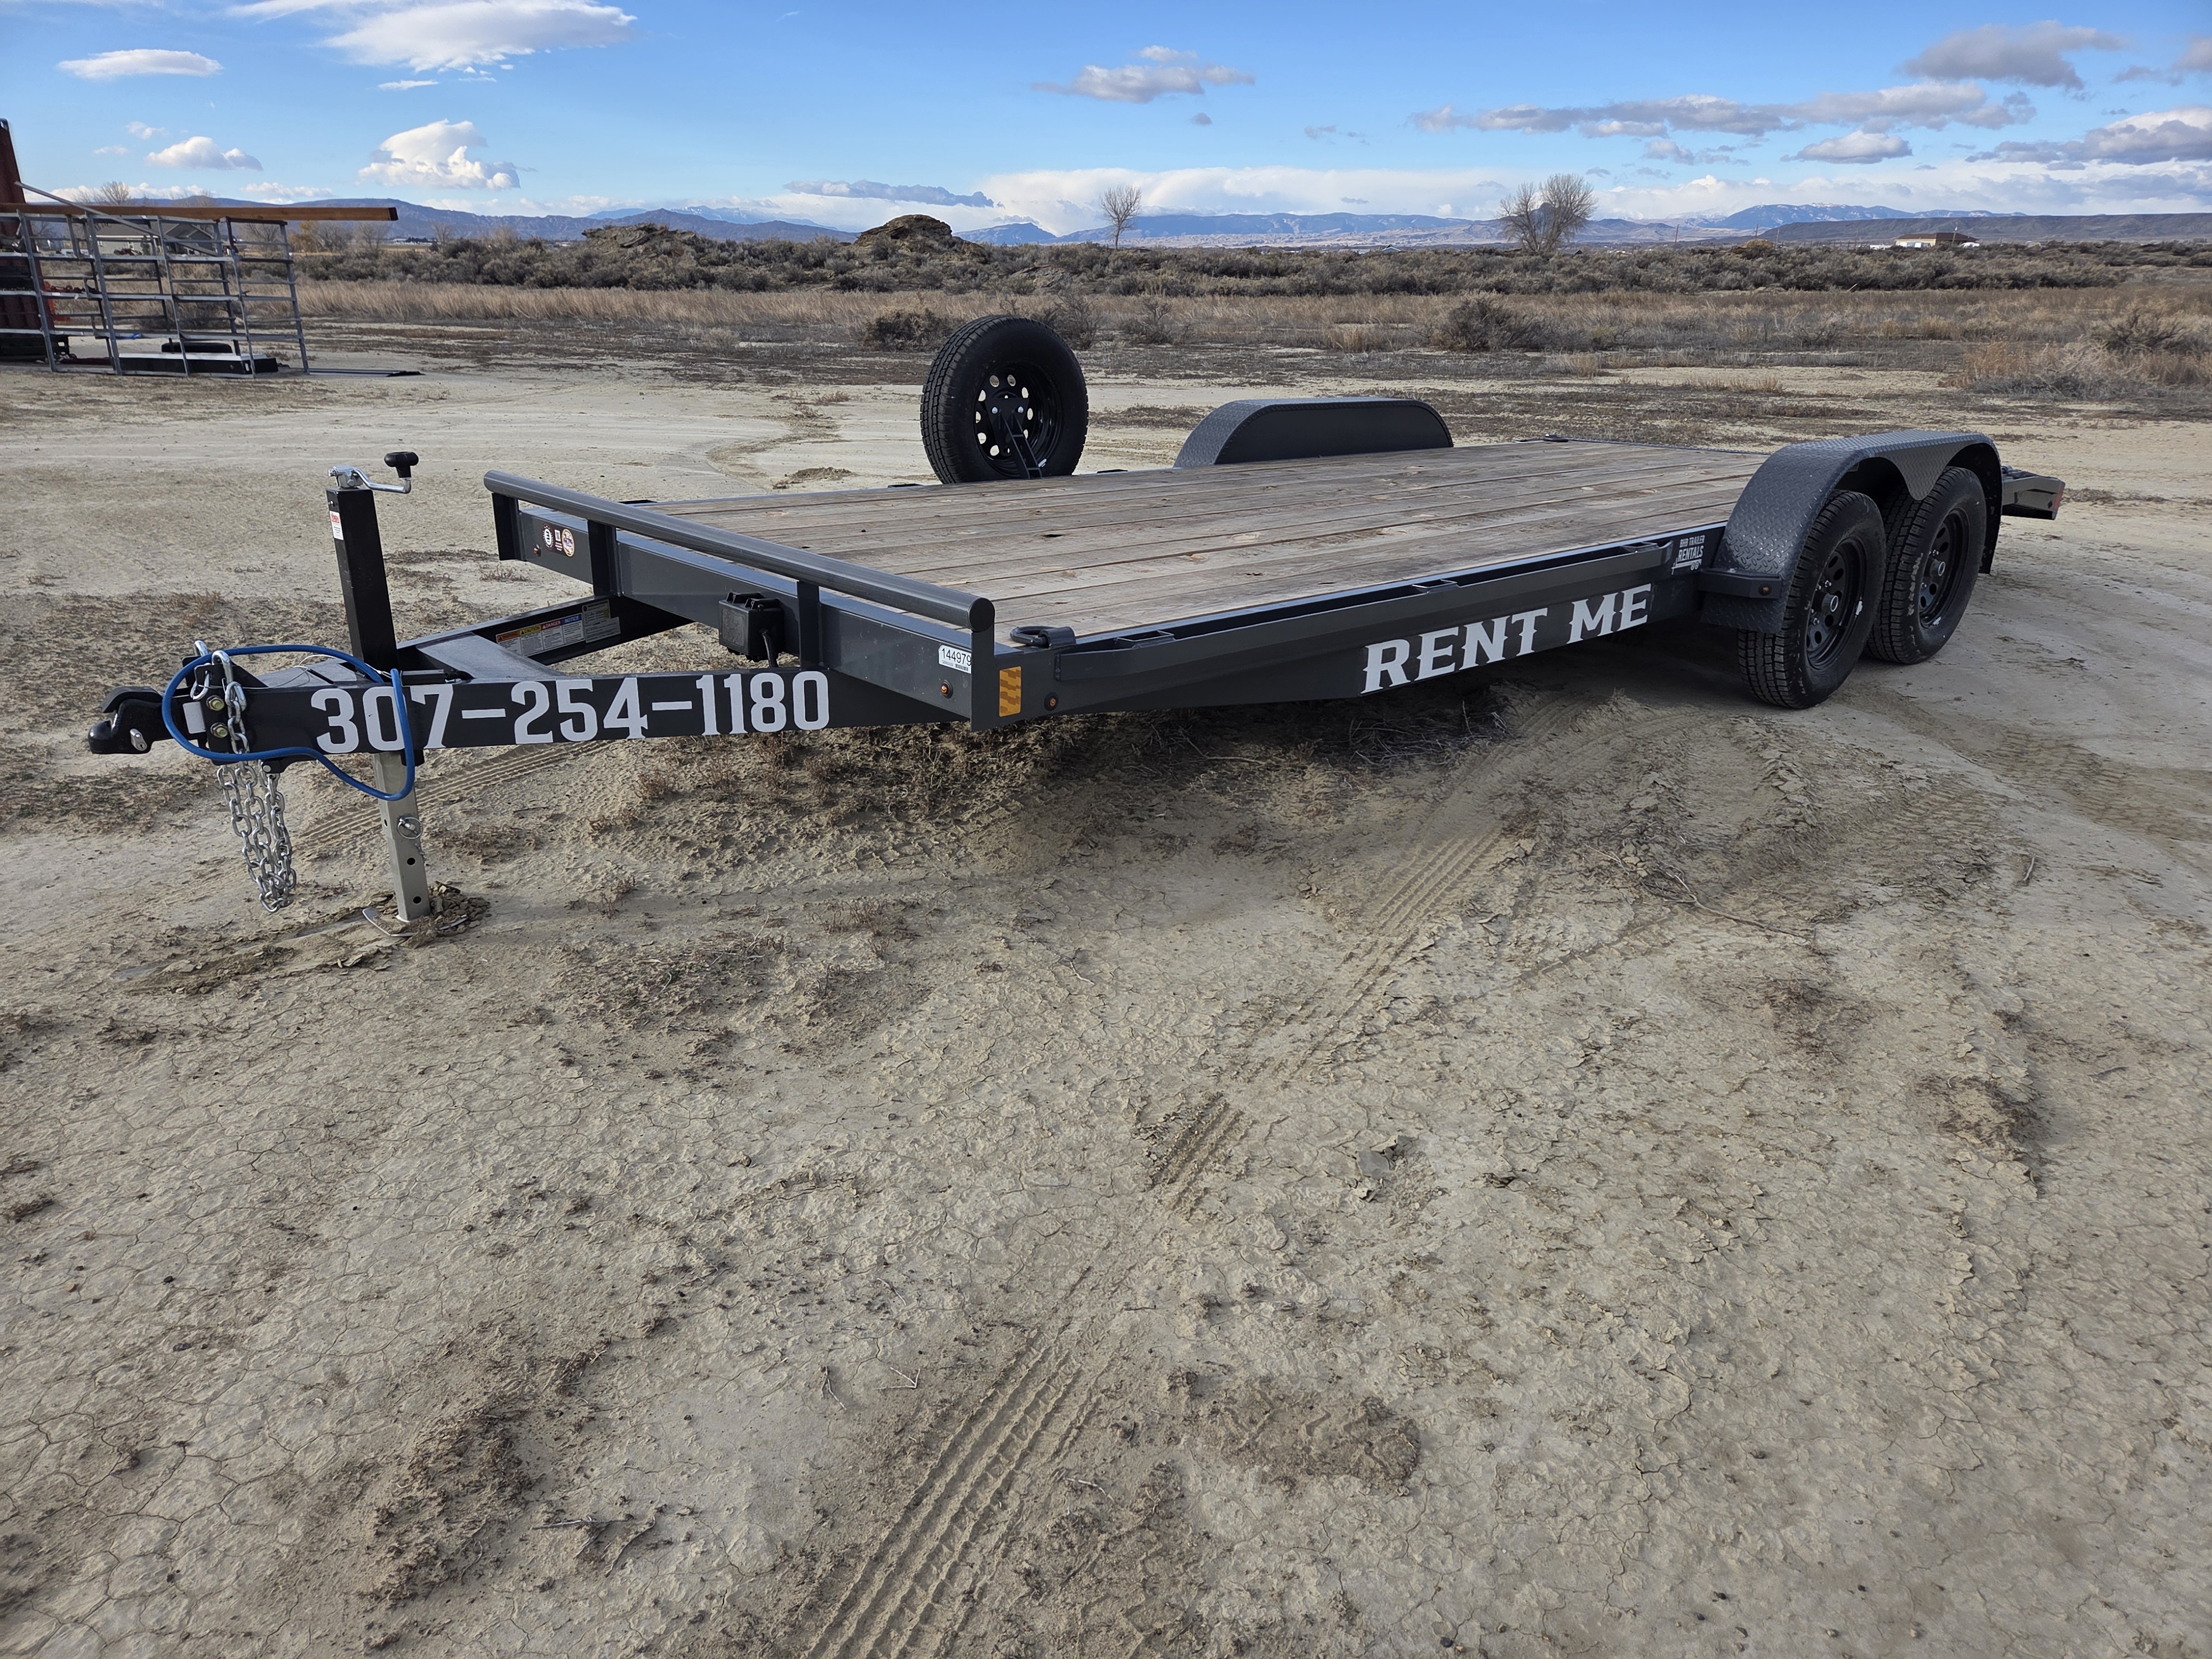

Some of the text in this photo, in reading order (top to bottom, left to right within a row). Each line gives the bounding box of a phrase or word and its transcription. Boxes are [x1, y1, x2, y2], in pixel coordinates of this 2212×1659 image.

[1689, 535, 1705, 546] TRAILER
[1678, 545, 1704, 562] RENTALS
[545, 620, 561, 628] DANGER
[564, 615, 580, 623] NOTICE
[1361, 583, 1651, 693] RENT ME
[942, 648, 972, 666] 144979
[310, 671, 830, 754] 307-254-1180
